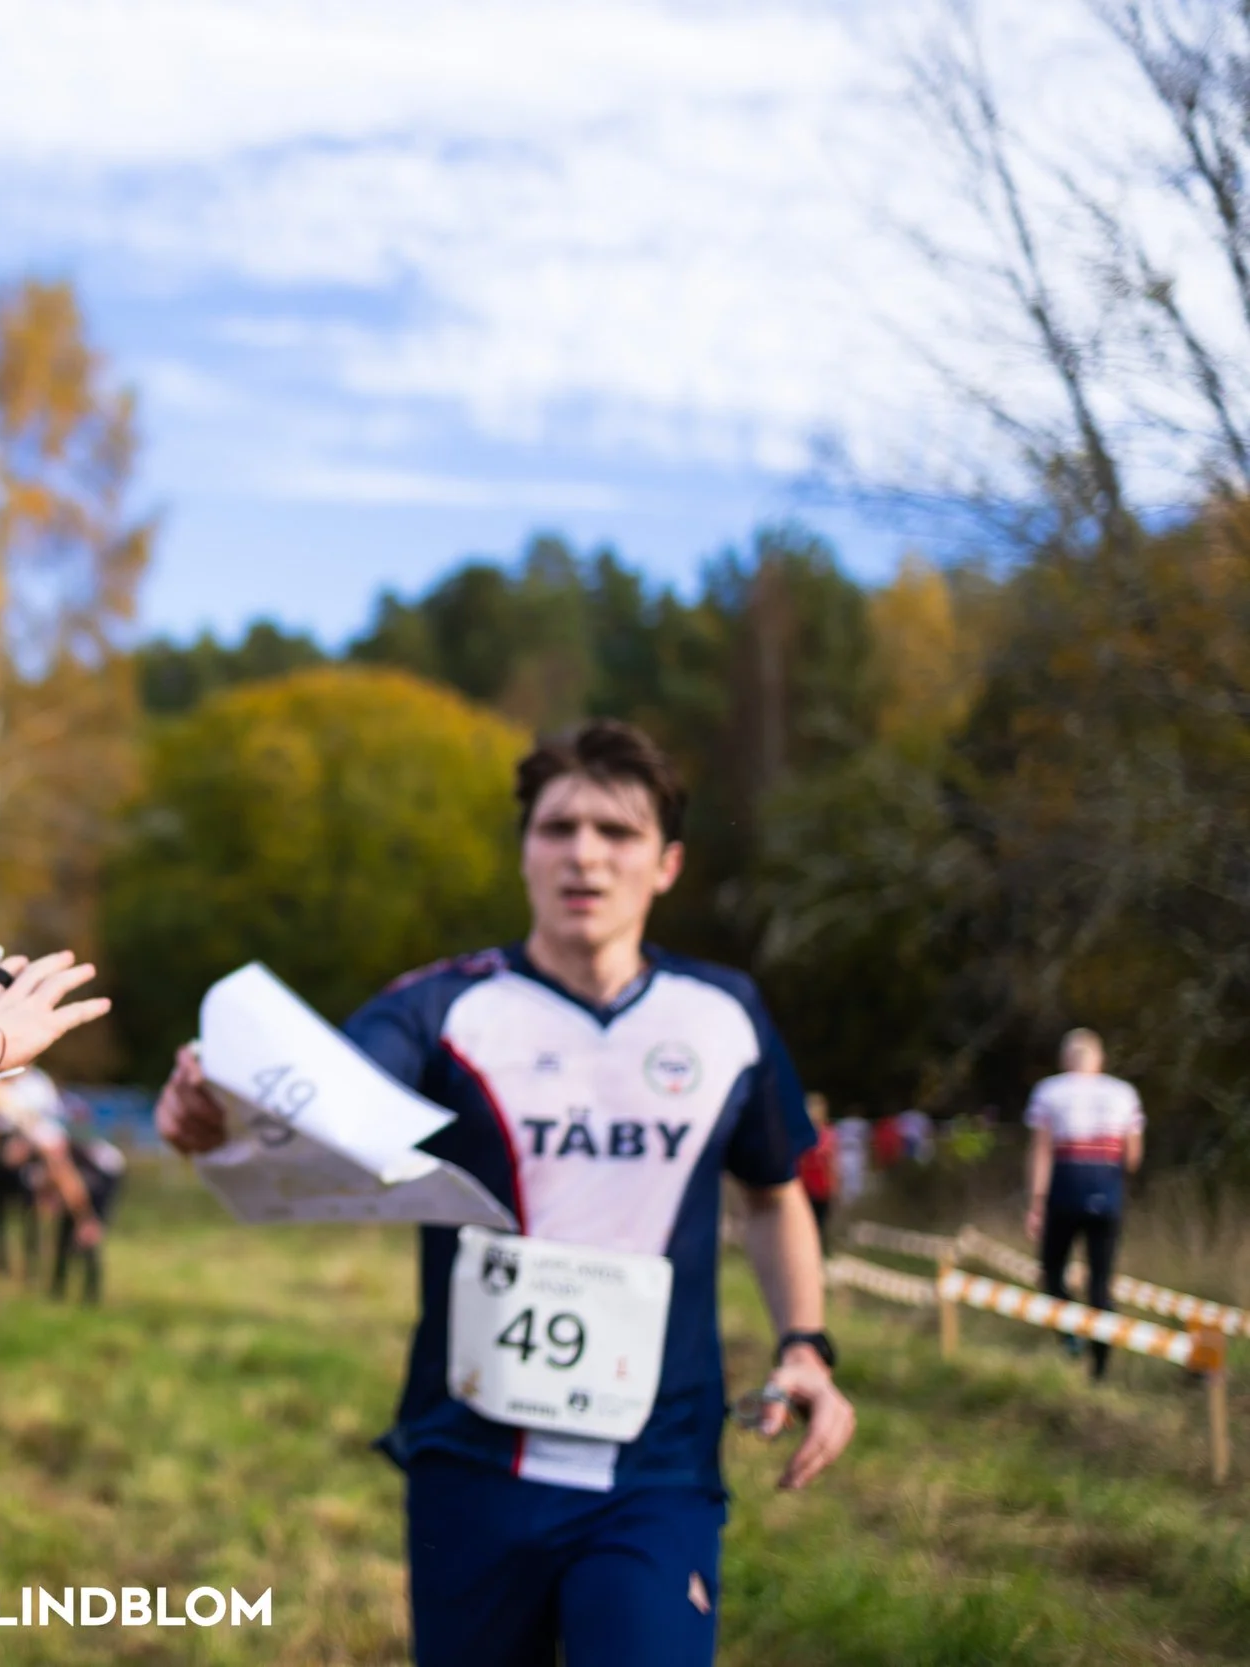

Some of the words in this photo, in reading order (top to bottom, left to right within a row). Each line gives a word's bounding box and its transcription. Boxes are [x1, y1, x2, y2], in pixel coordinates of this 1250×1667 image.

[252, 1064, 317, 1122] 49
[521, 1107, 692, 1160] TÄBY
[495, 1307, 587, 1371] 49
